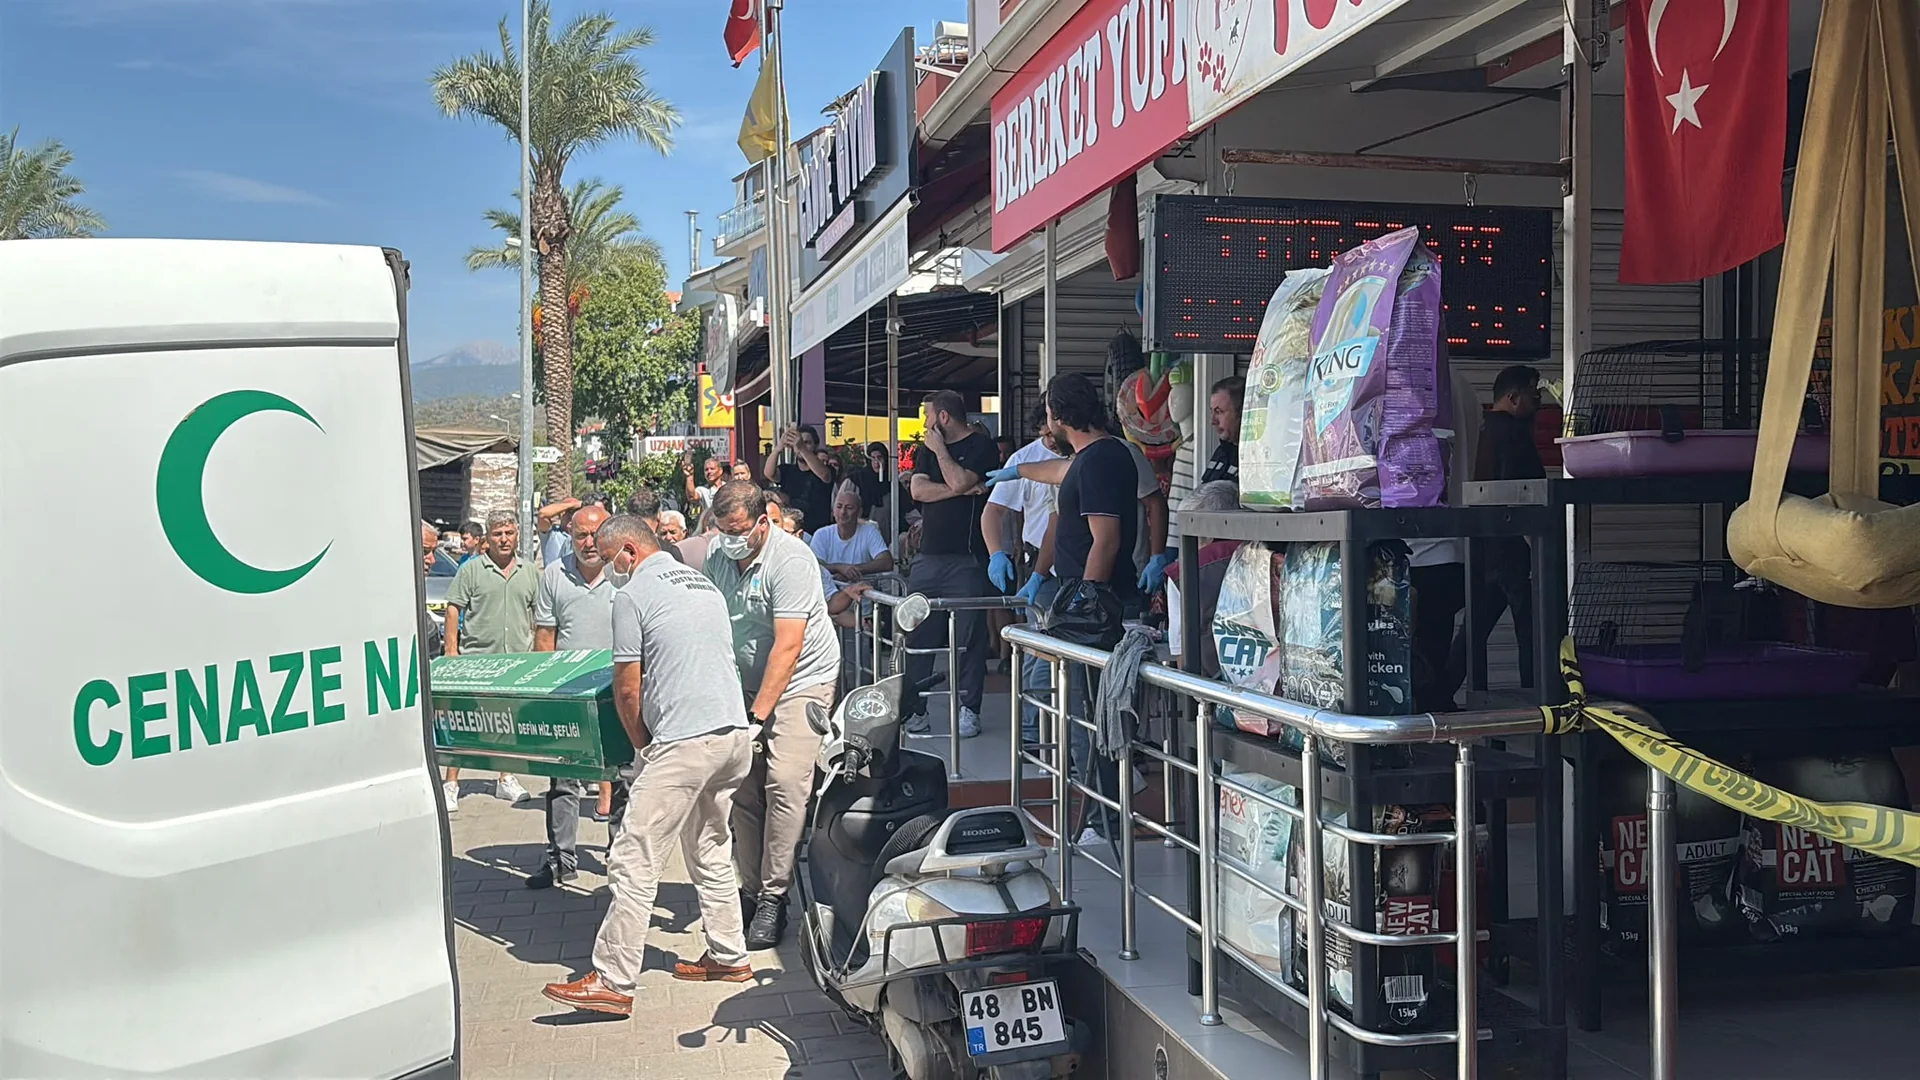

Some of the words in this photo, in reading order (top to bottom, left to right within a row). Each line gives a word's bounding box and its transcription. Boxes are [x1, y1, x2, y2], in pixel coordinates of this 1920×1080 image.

[995, 30, 1102, 214] BEREKET
[1312, 345, 1362, 382] KING
[1219, 637, 1274, 667] CAT
[1368, 661, 1403, 673] icken
[73, 645, 346, 767] CENAZE
[447, 706, 516, 735] BELEDİYESİ
[962, 827, 1001, 837] HONDA
[1618, 819, 1648, 850] NE
[1685, 841, 1727, 860] ADULT
[1782, 849, 1836, 884] CAT
[1325, 902, 1352, 926] DUL
[969, 993, 1001, 1020] 48
[1021, 986, 1054, 1013] BN
[1398, 1008, 1418, 1019] 15kg
[994, 1016, 1043, 1047] 845
[973, 1043, 985, 1053] TR
